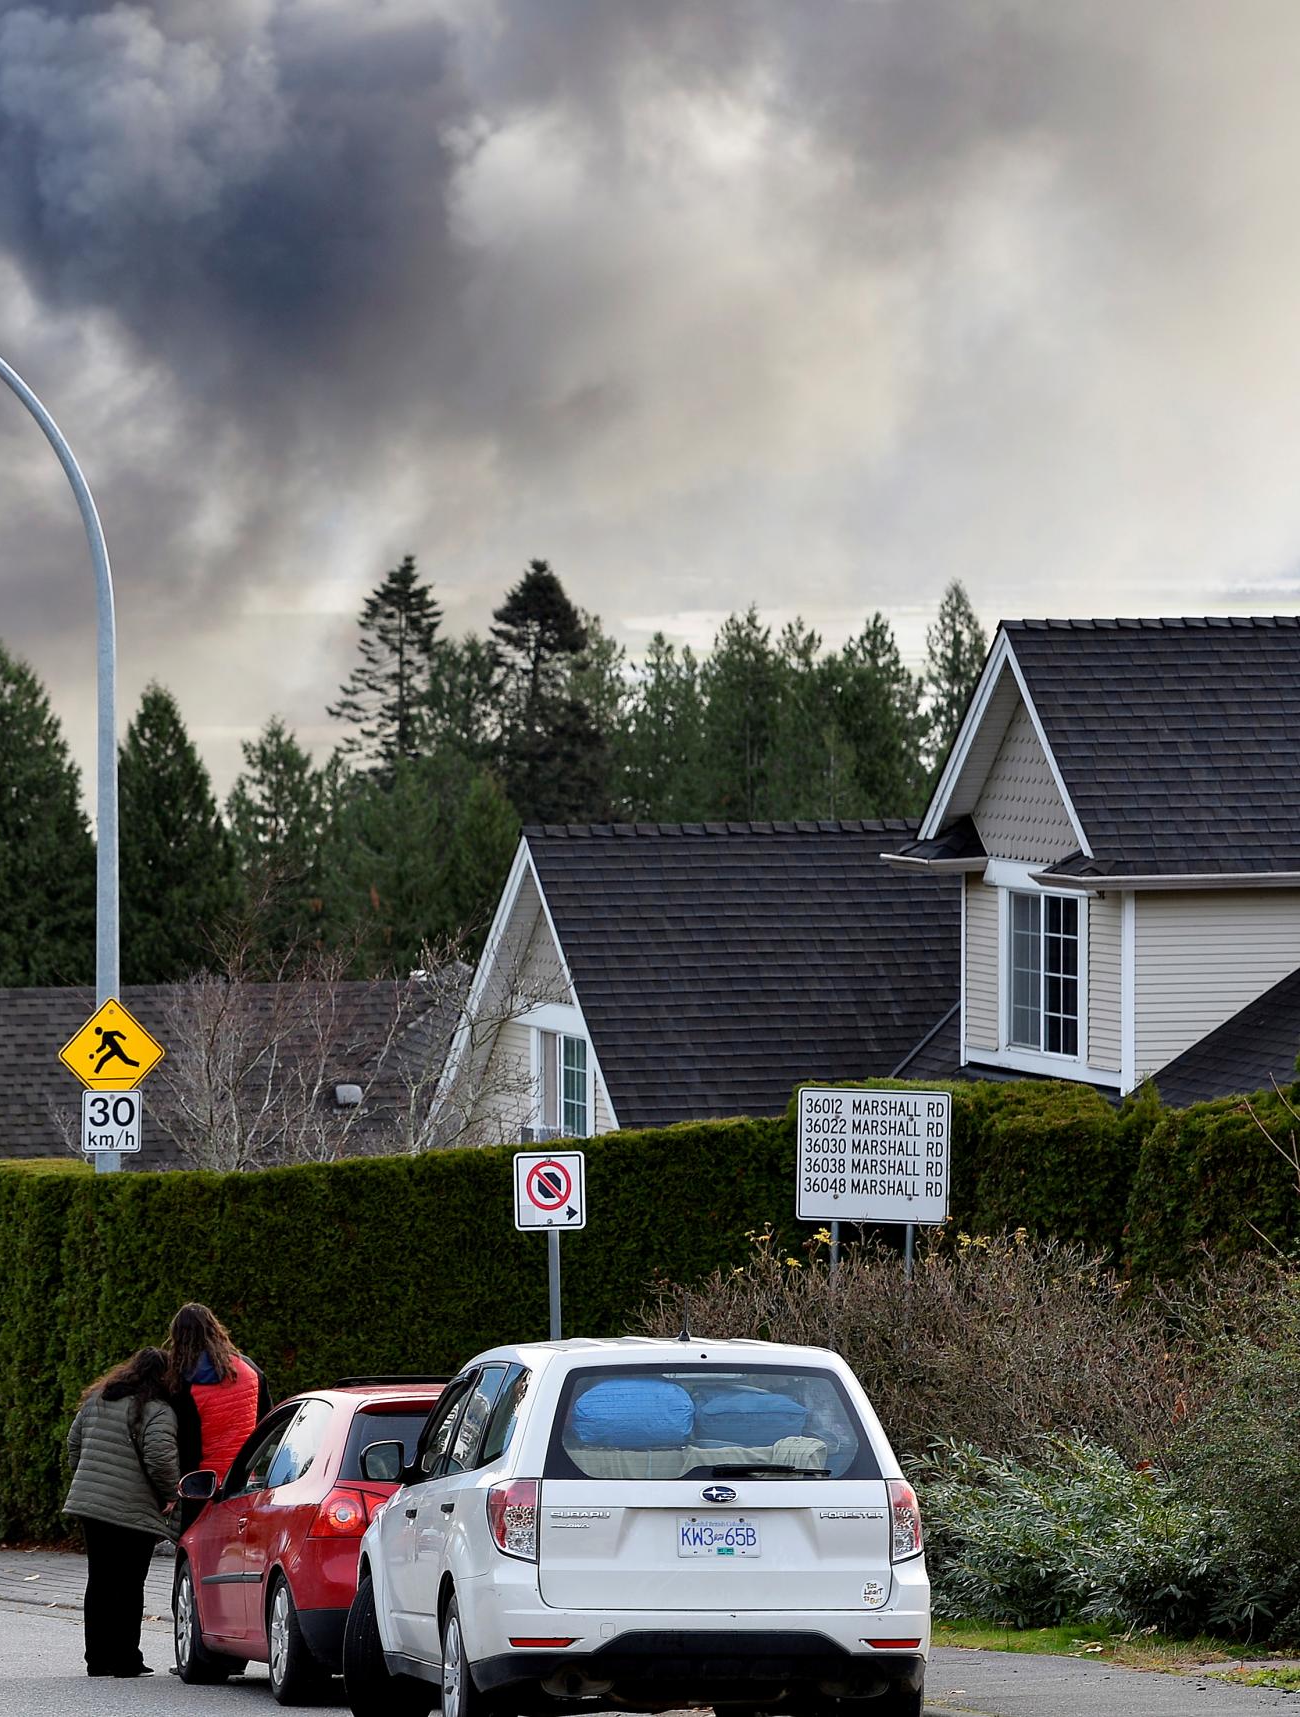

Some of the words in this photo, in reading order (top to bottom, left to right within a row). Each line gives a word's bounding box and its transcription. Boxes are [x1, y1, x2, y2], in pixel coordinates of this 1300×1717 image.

[89, 1097, 135, 1127] 30
[805, 1098, 843, 1114] 36012
[852, 1099, 921, 1117] MARSHALL
[927, 1102, 944, 1118] RD
[805, 1118, 847, 1134] 36022
[852, 1120, 921, 1137] MARSHALL
[926, 1122, 944, 1138] RD
[88, 1129, 135, 1147] km/h
[805, 1138, 846, 1154] 36030
[851, 1139, 920, 1157] MARSHALL
[926, 1142, 944, 1157] RD
[804, 1158, 846, 1174] 36038
[851, 1159, 920, 1176] MARSHALL
[926, 1161, 943, 1177] RD
[804, 1177, 846, 1194] 36048
[851, 1179, 919, 1197] MARSHALL
[925, 1181, 943, 1197] RD
[550, 1511, 610, 1519] SUBARU
[820, 1511, 884, 1519] FORESTER
